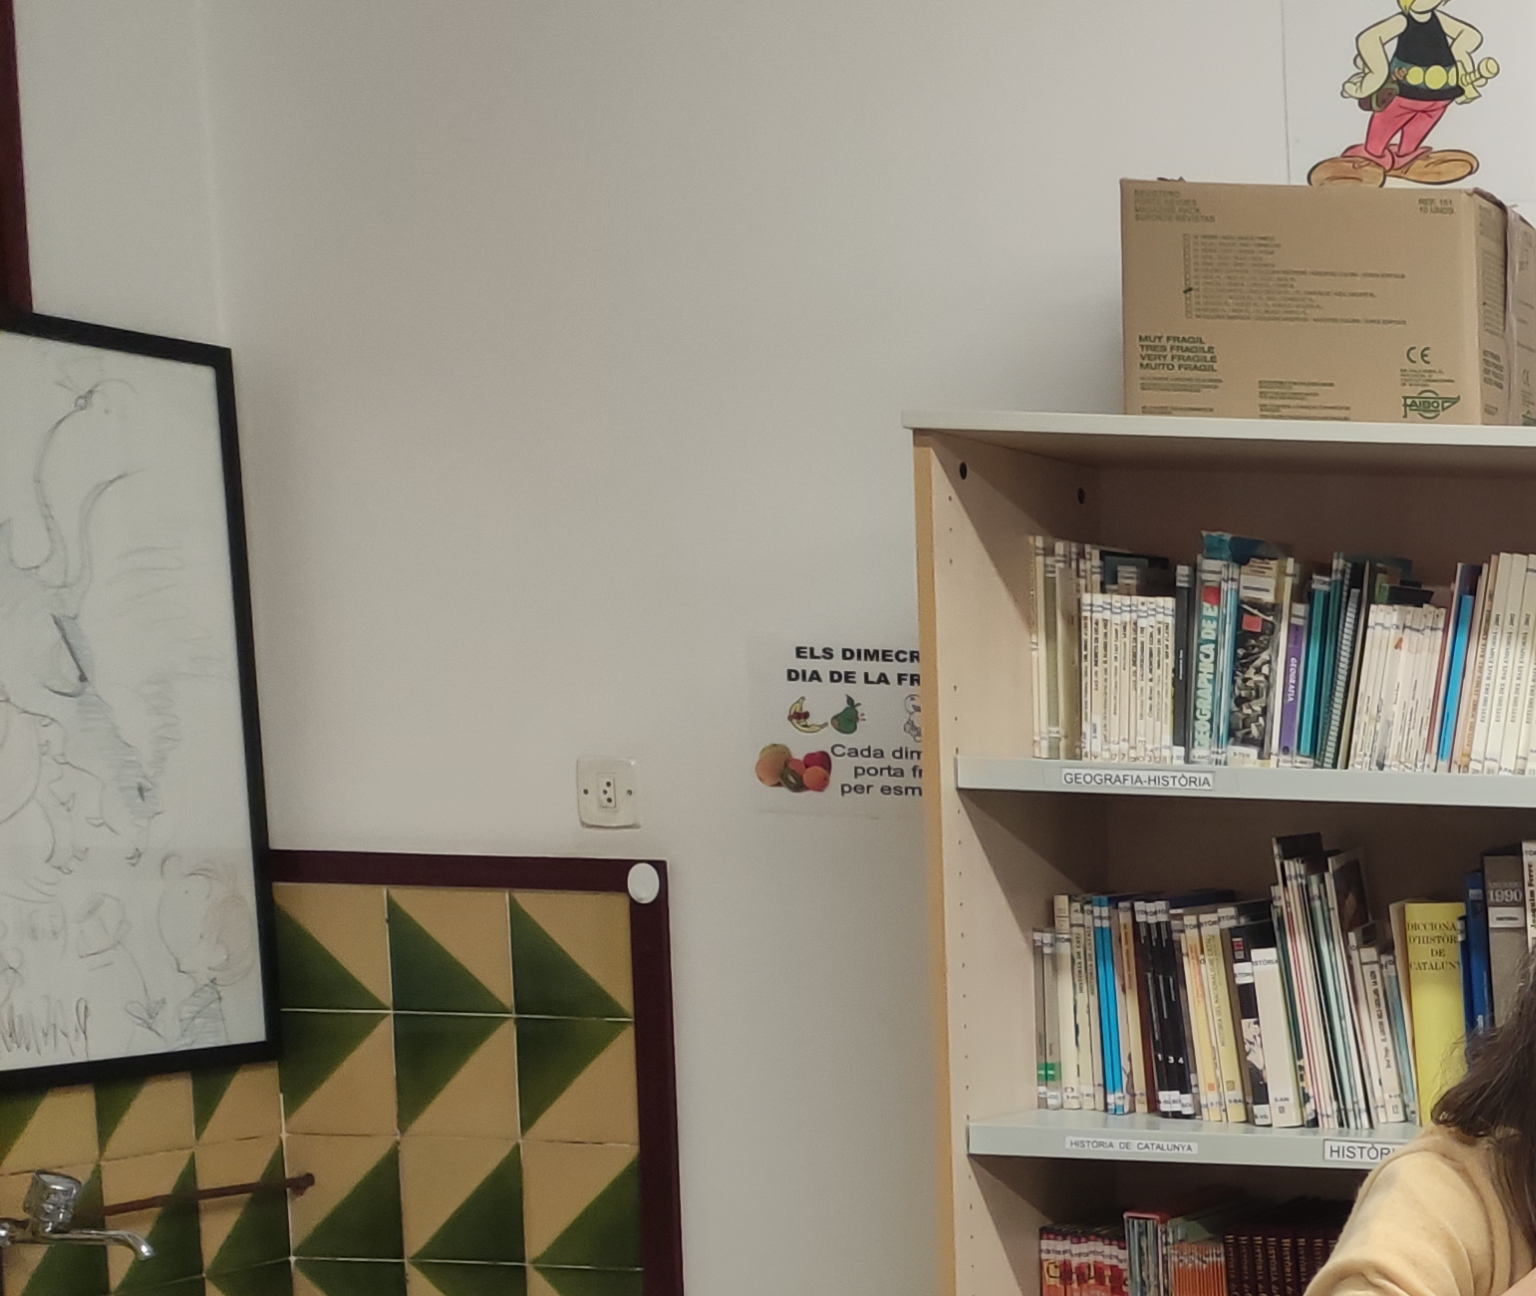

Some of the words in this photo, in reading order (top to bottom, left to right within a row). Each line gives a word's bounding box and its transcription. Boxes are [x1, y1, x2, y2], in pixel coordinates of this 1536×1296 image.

[1166, 336, 1204, 344] FRAGIL
[1140, 354, 1167, 362] VERY
[1171, 355, 1217, 363] FRAGILE
[1140, 363, 1175, 371] MUITO
[1178, 364, 1217, 372] FRAGIL
[795, 646, 833, 660] ELS
[787, 669, 822, 682] DIA
[830, 670, 856, 683] DE
[864, 672, 890, 685] LA
[831, 744, 884, 759] Cada
[854, 765, 904, 779] porta
[1064, 771, 1211, 789] GEOGRAFIA-HISTÒRIA
[841, 783, 873, 797] per
[1488, 888, 1523, 902] 1990
[1430, 948, 1445, 958] DE
[1070, 1139, 1114, 1150] HISTÒRIA
[1119, 1141, 1133, 1150] DE
[1137, 1143, 1192, 1153] CATALUNYA
